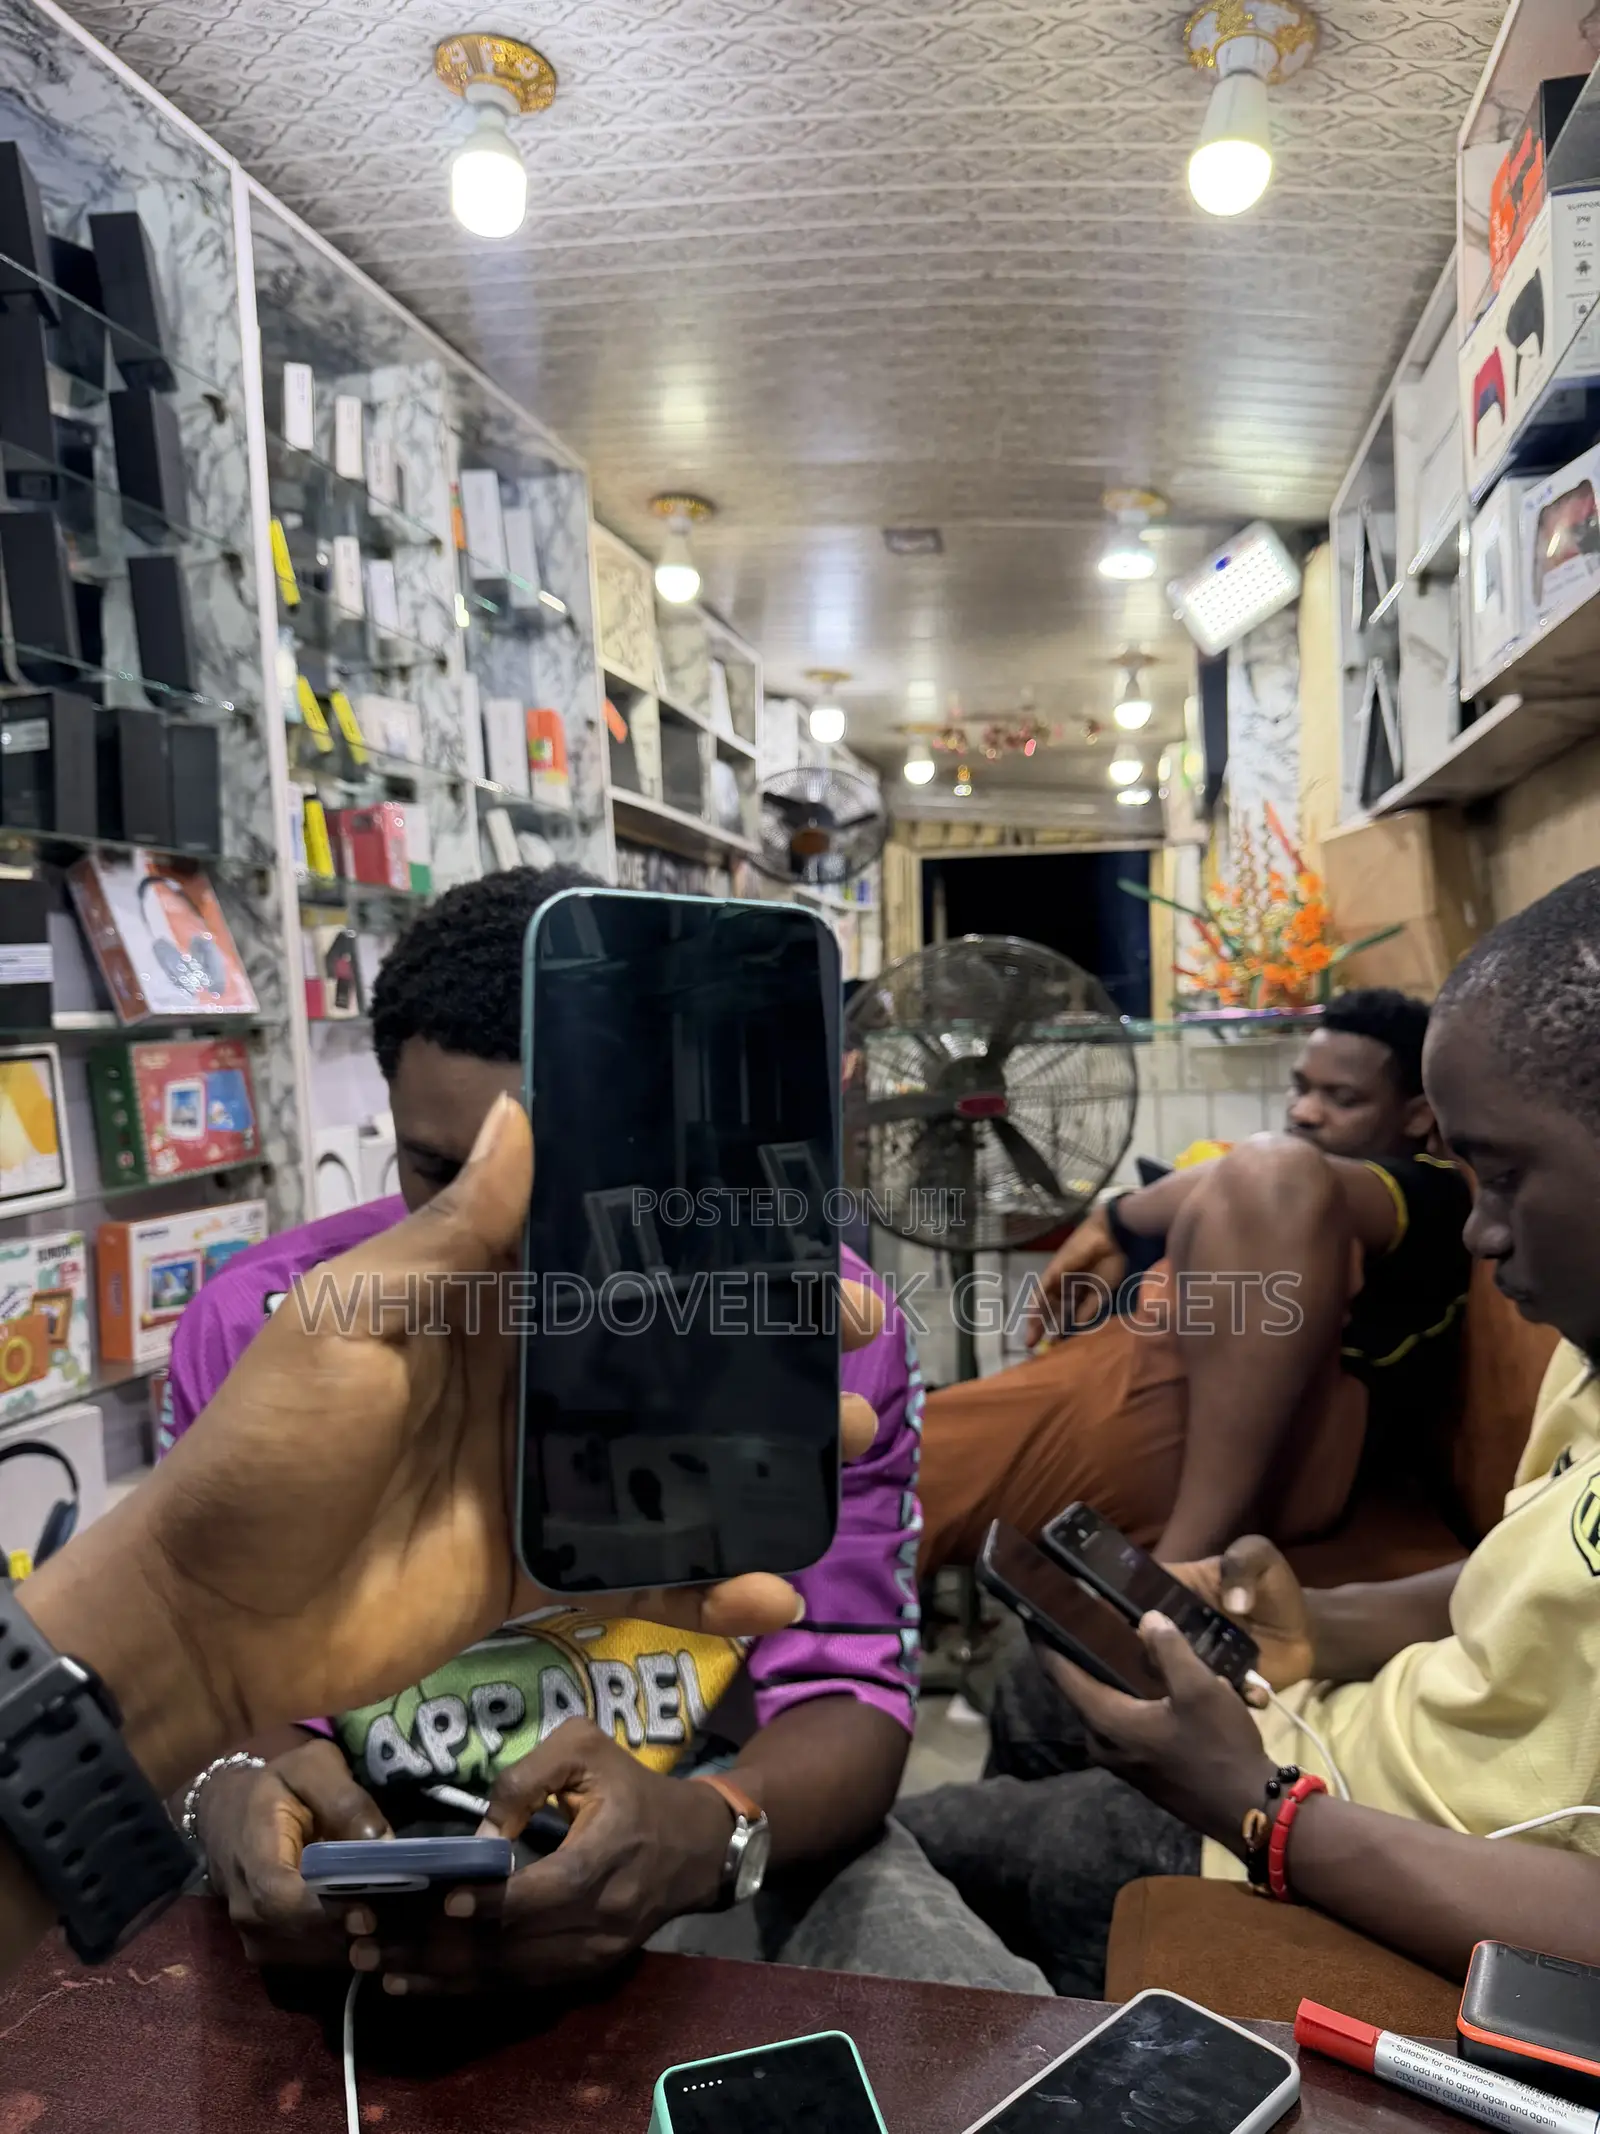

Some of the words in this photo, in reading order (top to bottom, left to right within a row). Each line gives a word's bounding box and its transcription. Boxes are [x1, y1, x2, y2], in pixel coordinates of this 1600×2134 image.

[1393, 2055, 1411, 2069] Can
[1413, 2064, 1431, 2077] add
[1432, 2072, 1444, 2083] ink
[1445, 2075, 1455, 2086] to
[1456, 2081, 1481, 2099] apply
[1482, 2092, 1508, 2109] again
[1509, 2102, 1529, 2117] and
[1529, 2110, 1557, 2129] again
[1396, 2044, 1429, 2063] Suitable
[1431, 2057, 1442, 2068] for
[1444, 2063, 1461, 2076] any
[1462, 2071, 1495, 2088] surface
[1395, 2070, 1416, 2086] CIXI
[1418, 2078, 1441, 2096] CITY
[1442, 2089, 1512, 2125] GUANHAIWEI
